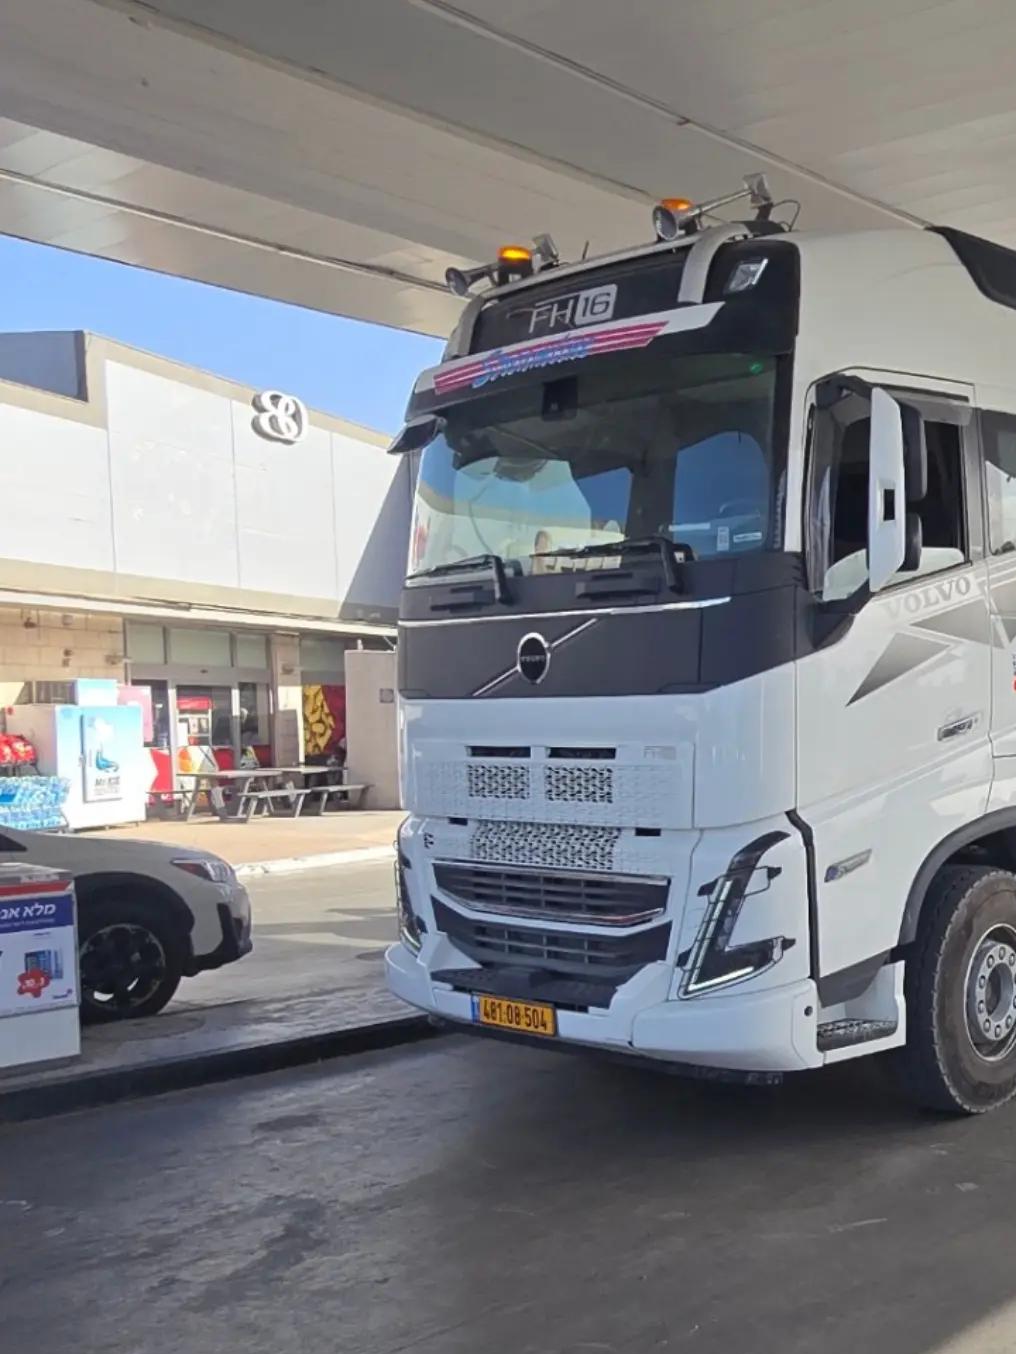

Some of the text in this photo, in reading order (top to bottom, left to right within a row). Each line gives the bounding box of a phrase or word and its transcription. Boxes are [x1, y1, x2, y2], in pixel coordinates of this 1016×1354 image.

[529, 284, 617, 333] FH16
[883, 574, 971, 618] VOLVO
[23, 902, 56, 917] מלא
